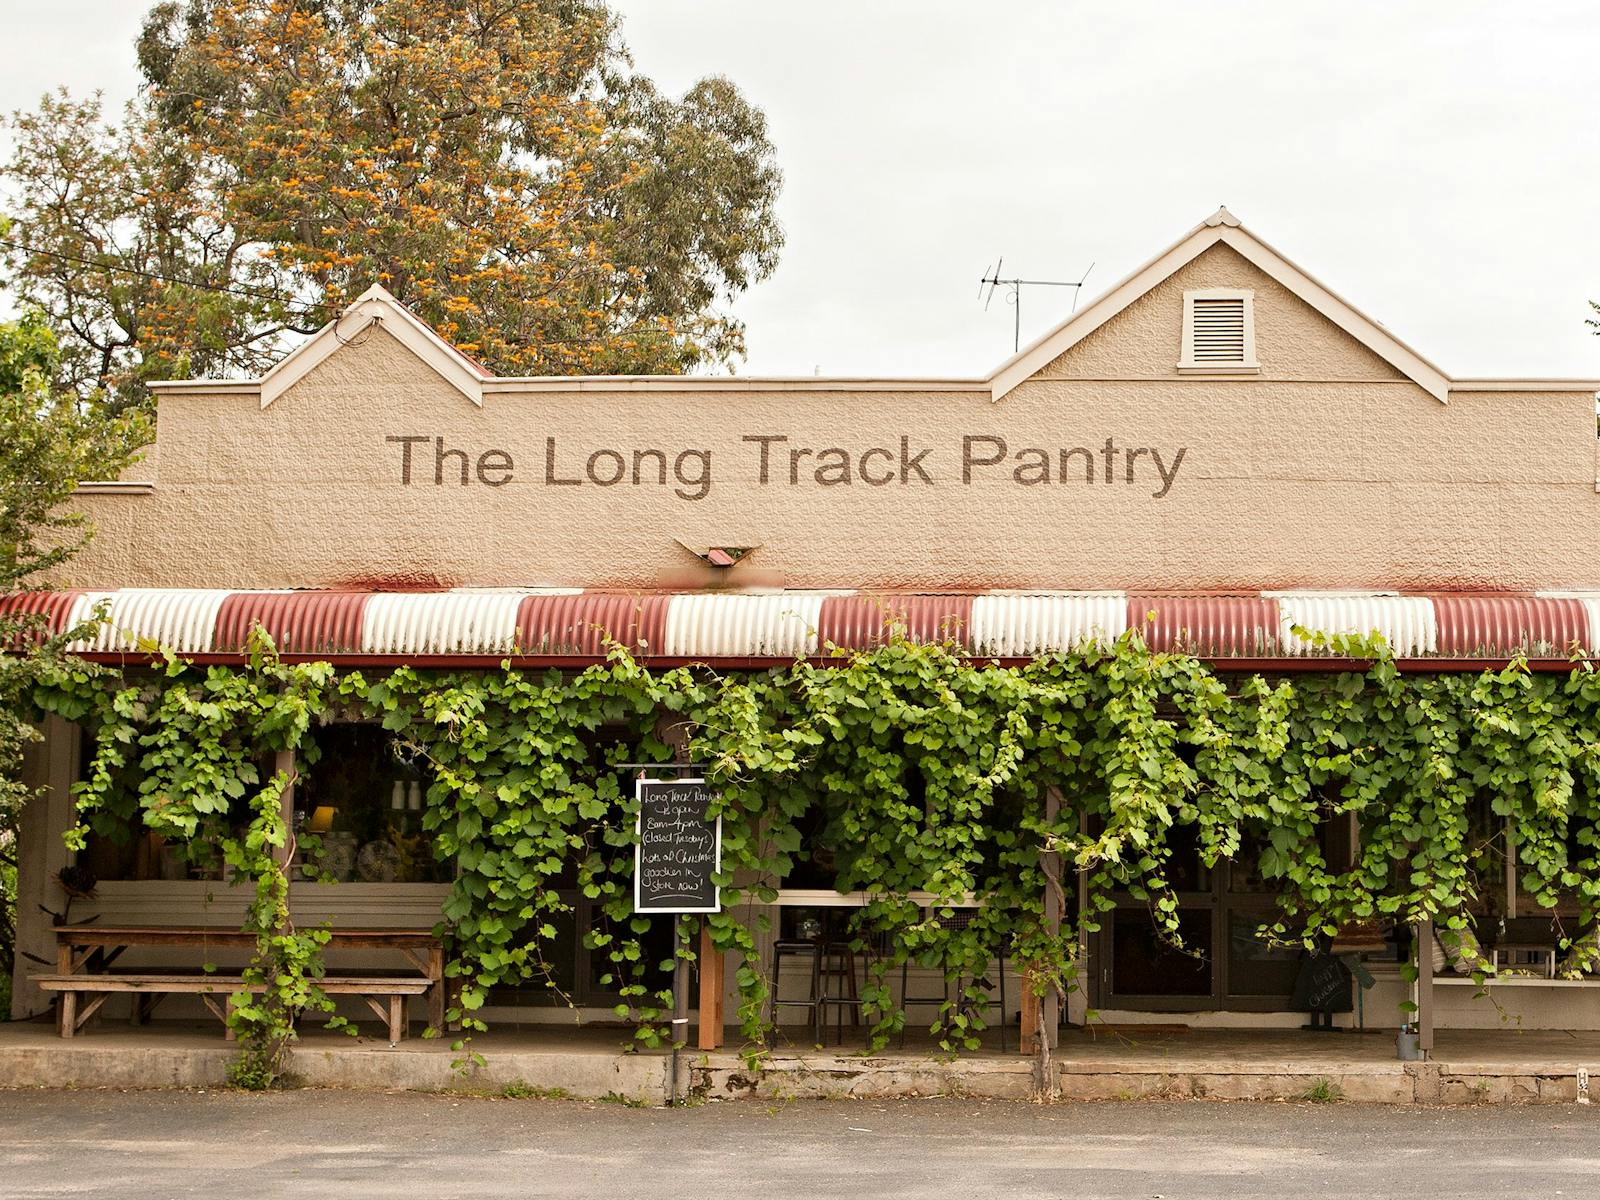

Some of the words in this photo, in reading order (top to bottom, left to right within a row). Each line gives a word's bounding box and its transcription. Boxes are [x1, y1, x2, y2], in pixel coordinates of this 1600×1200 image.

[386, 435, 514, 487] The
[545, 436, 712, 501] Long
[742, 435, 935, 486] Track
[962, 435, 1188, 499] Pantry
[645, 786, 669, 807] Long
[672, 806, 699, 817] open
[663, 850, 675, 861] of
[642, 867, 681, 887] goodies
